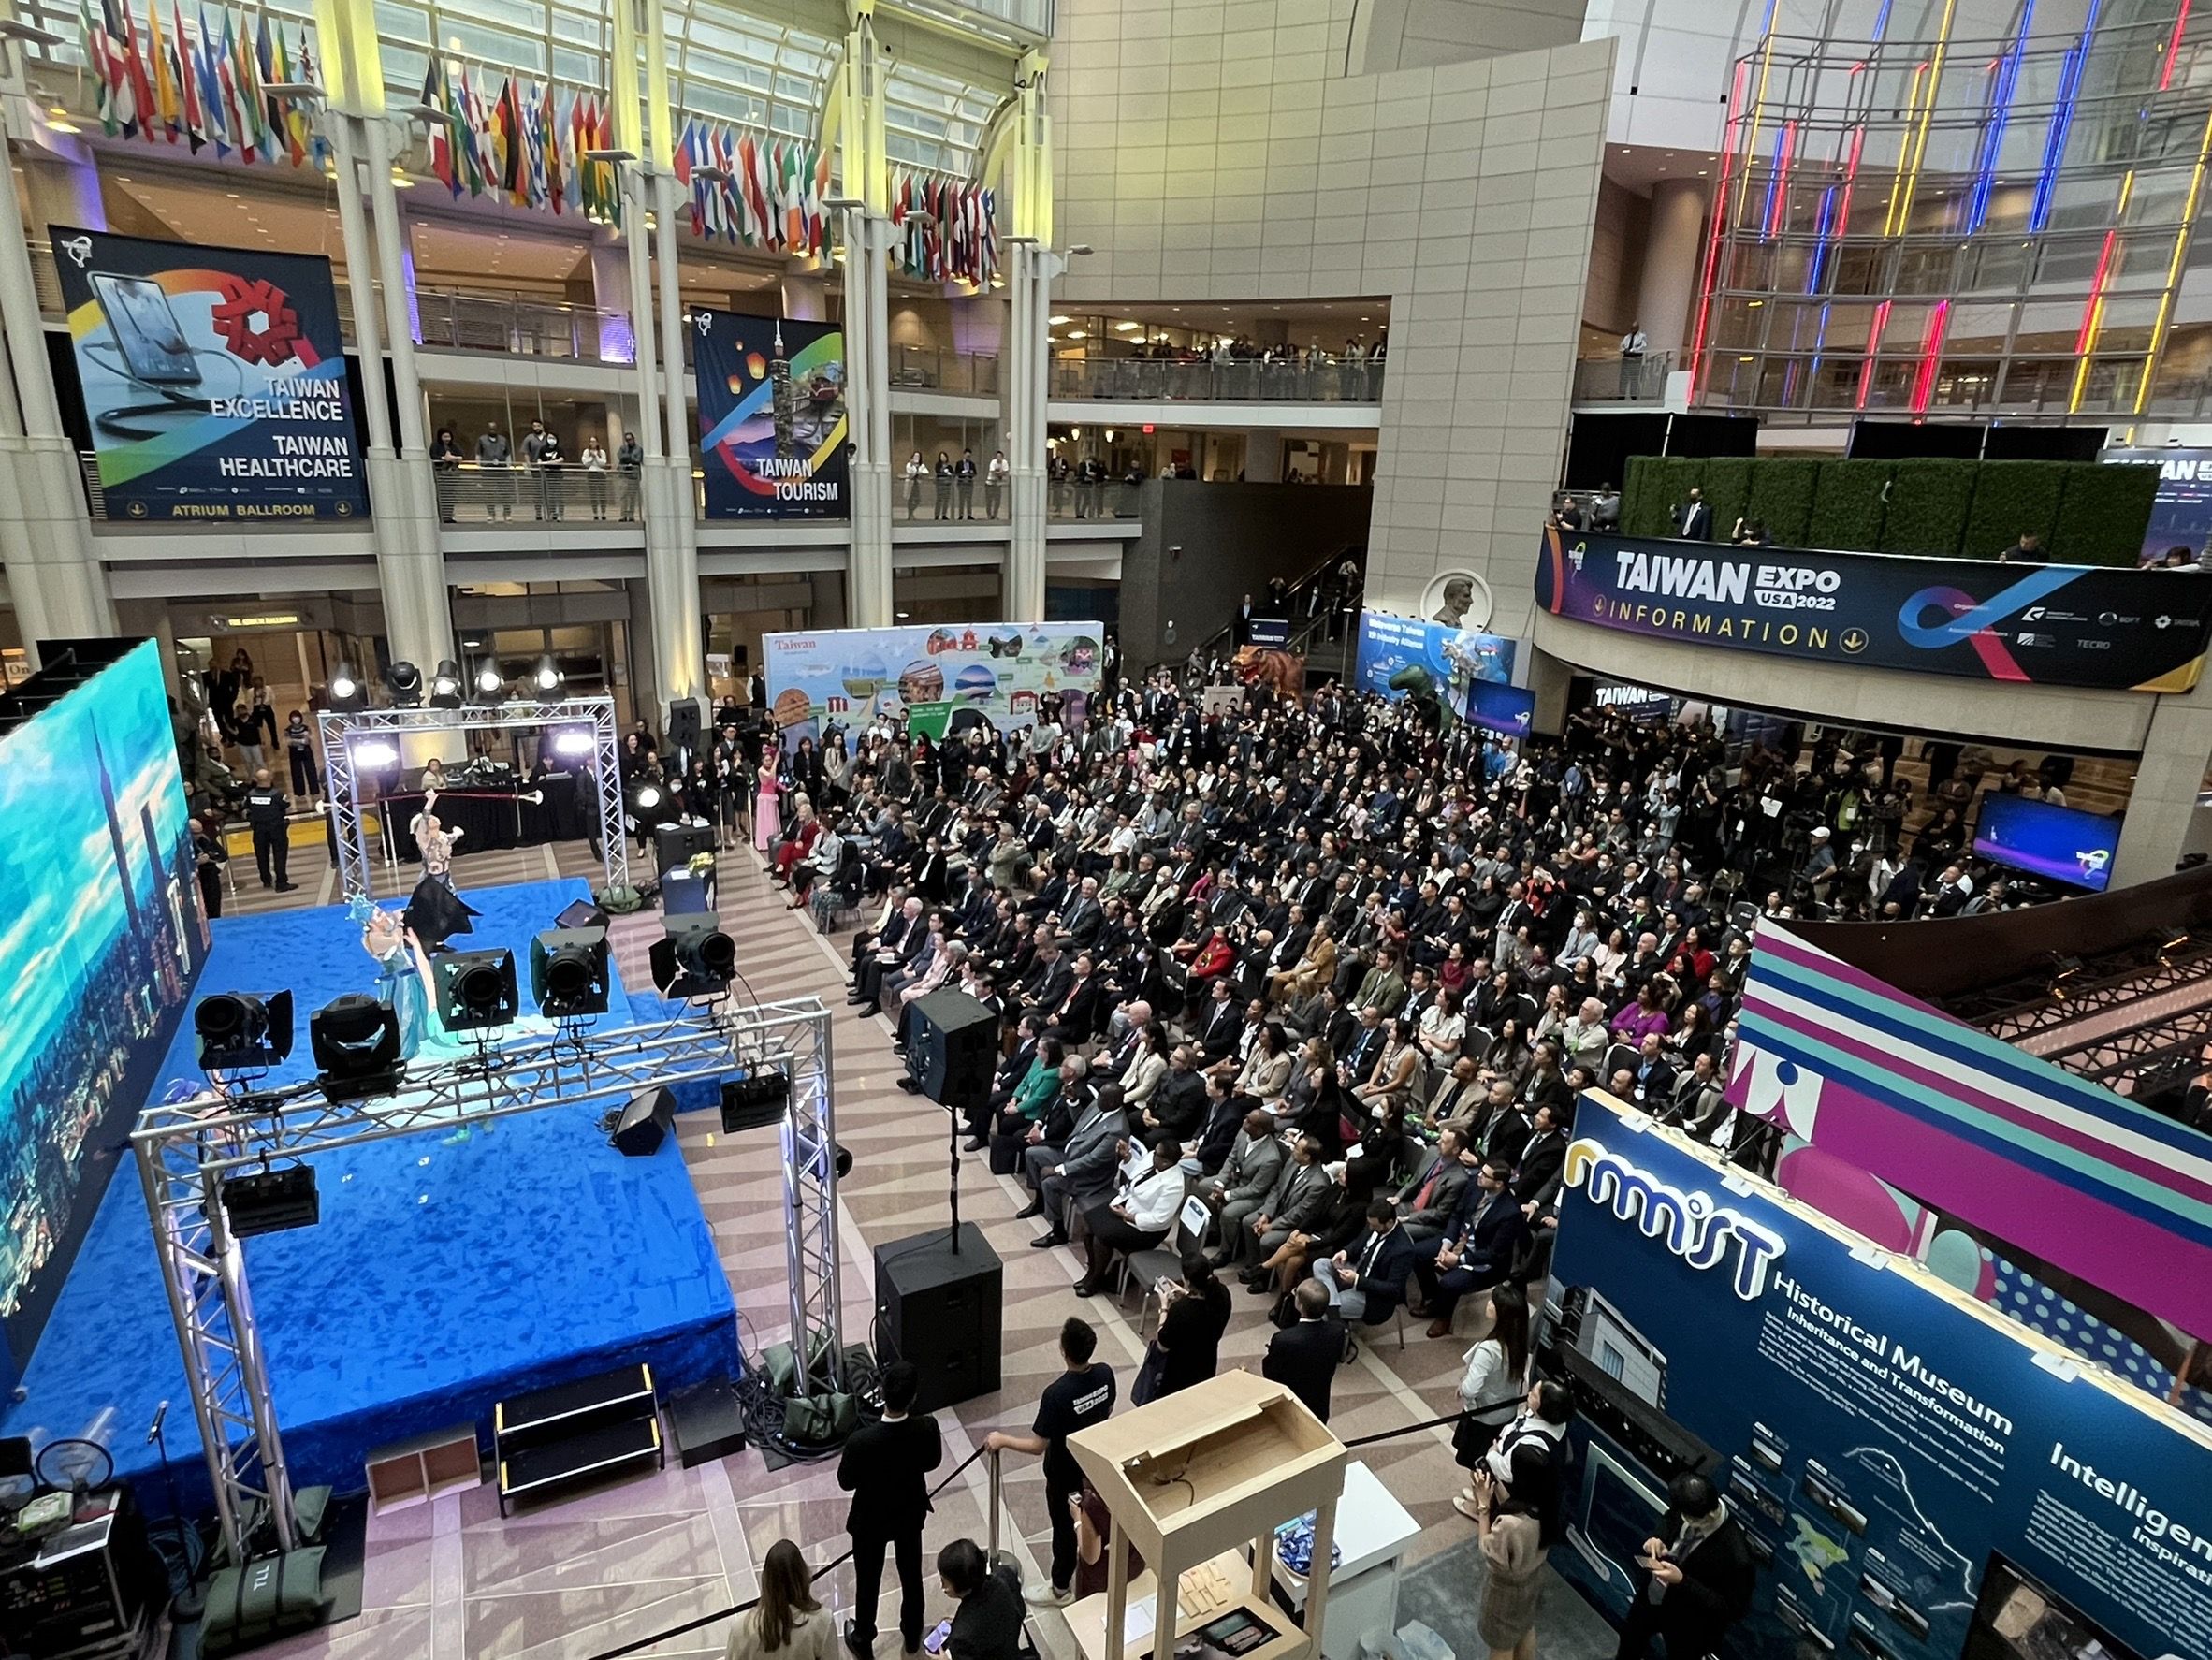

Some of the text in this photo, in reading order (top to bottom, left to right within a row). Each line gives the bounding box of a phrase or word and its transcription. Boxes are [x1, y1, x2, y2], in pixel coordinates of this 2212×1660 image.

[264, 377, 340, 399] TAIWAN
[211, 398, 343, 421] EXCELLENCE
[272, 435, 349, 456] TAIWAN
[219, 458, 353, 478] HEALTHCARE
[756, 459, 813, 478] TAIWAN
[773, 482, 838, 501] TOURISM
[172, 504, 315, 516] ATRIUM BALLROOM
[1616, 551, 1751, 604] TAIWAN
[1756, 565, 1841, 593] EXPO
[1761, 591, 1836, 610] USA 2022
[1609, 600, 1828, 648] INFORMATION
[775, 639, 816, 650] Taiwan
[2077, 639, 2111, 650] TECRO
[1595, 686, 1648, 707] TAIWAN
[1773, 1270, 1888, 1357] Historical
[1890, 1344, 2014, 1436] Museum
[1787, 1306, 2006, 1455] Inheritance and Transformation
